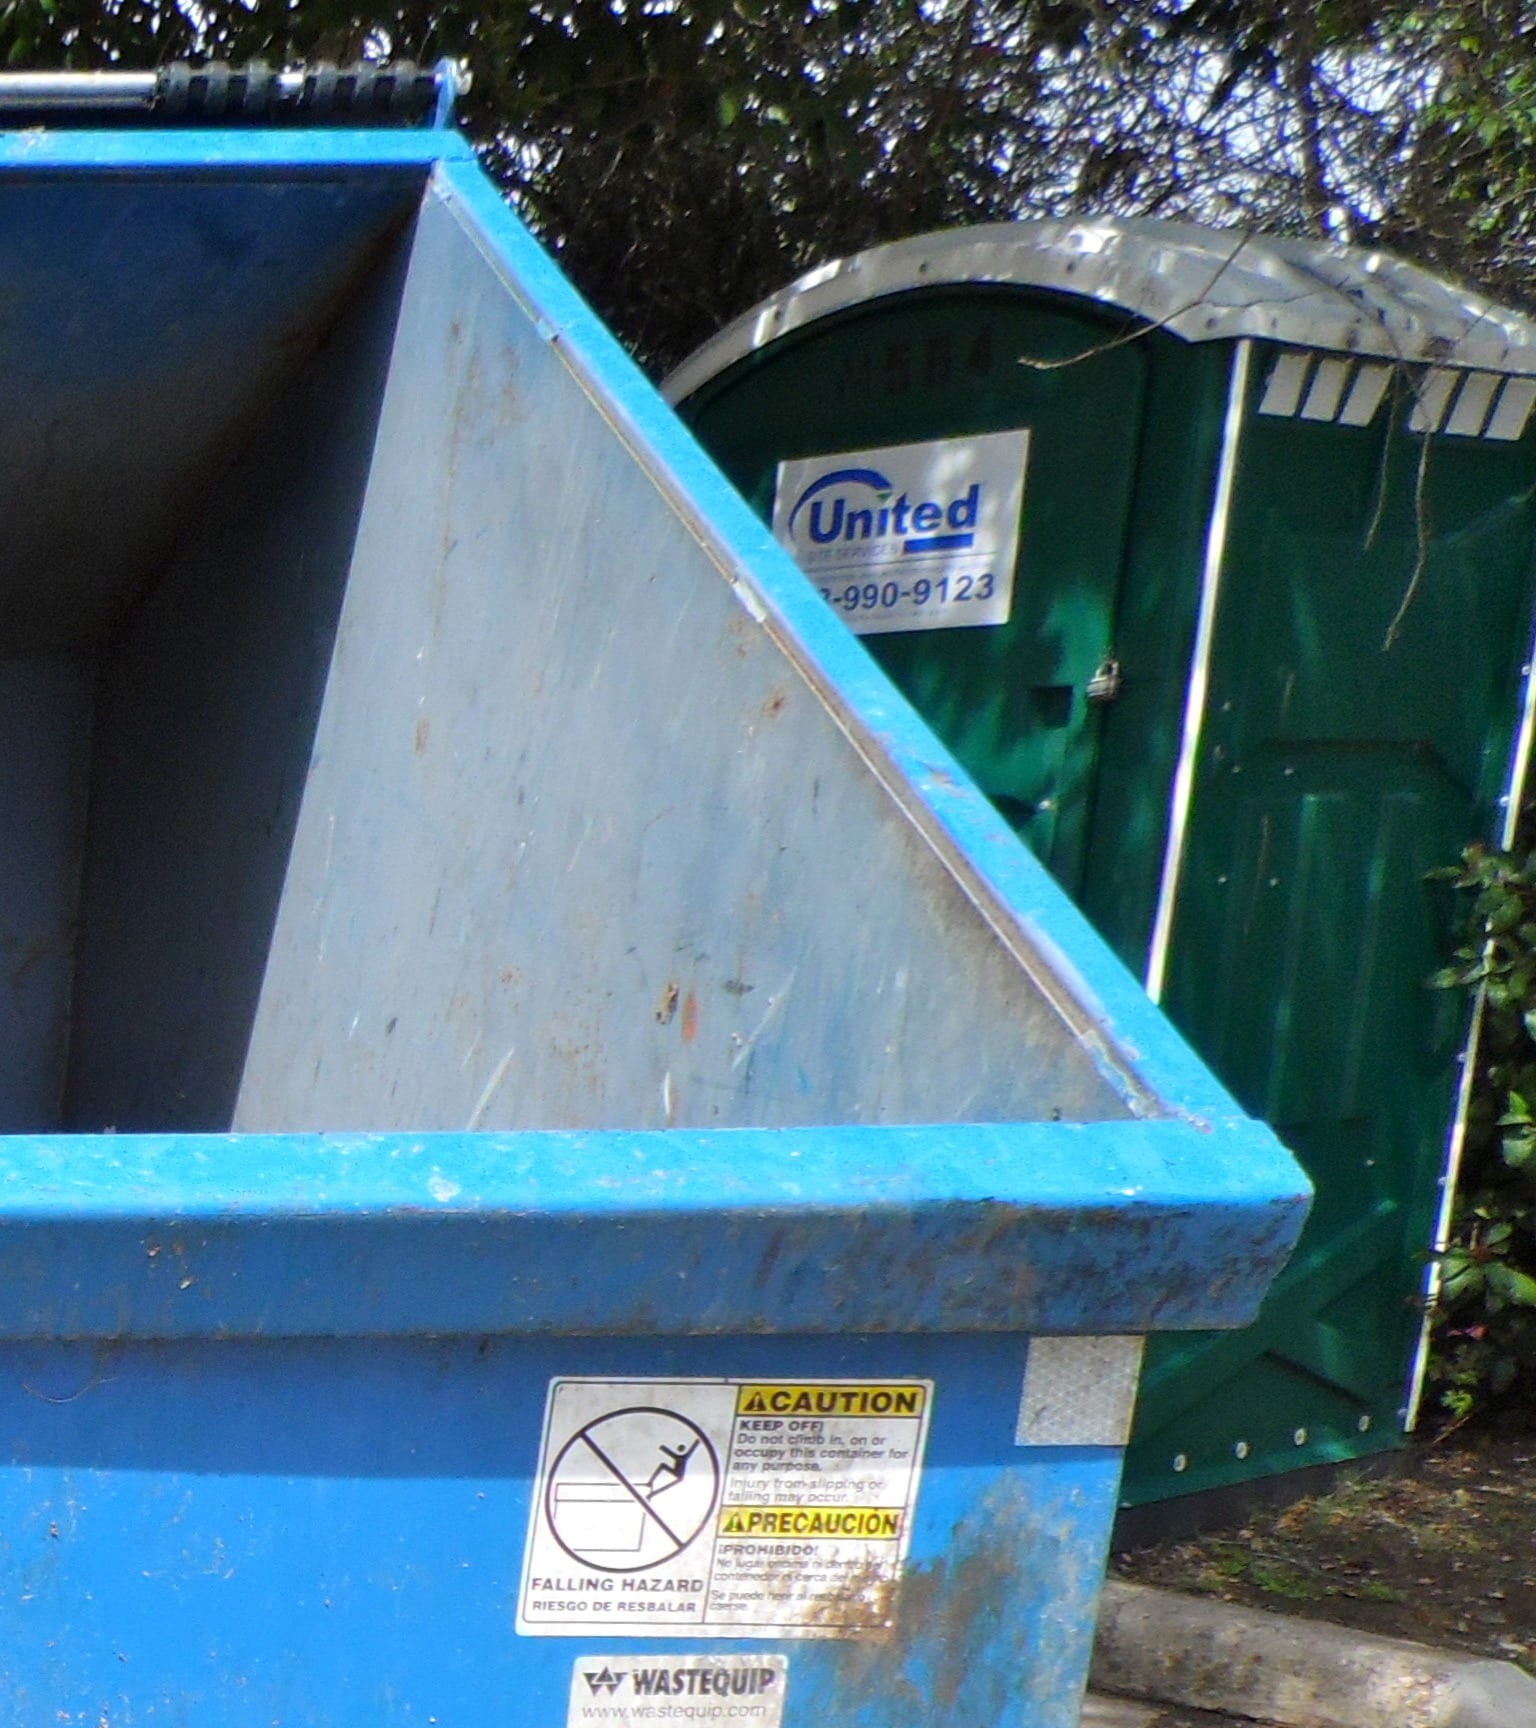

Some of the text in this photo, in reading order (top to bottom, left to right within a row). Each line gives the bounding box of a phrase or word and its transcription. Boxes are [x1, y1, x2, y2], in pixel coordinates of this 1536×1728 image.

[809, 484, 981, 544] United
[769, 1390, 918, 1413] CAUTION
[738, 1420, 785, 1432] KEEP
[736, 1433, 757, 1445] Do
[760, 1434, 785, 1445] not
[787, 1433, 826, 1445] climb
[849, 1436, 868, 1446] on
[871, 1436, 887, 1446] or
[733, 1448, 910, 1461] occupy this container for
[731, 1462, 762, 1473] any
[728, 1477, 770, 1491] Injury
[728, 1491, 771, 1505] falling
[774, 1492, 806, 1504] may
[747, 1508, 899, 1535] PRECAUCIÓN
[530, 1577, 705, 1593] FALLING HAZARD
[531, 1600, 697, 1613] RIESGO DE RESBALAR
[632, 1667, 776, 1698] WASTEQUIP
[580, 1703, 768, 1721] www.wastequip.com
